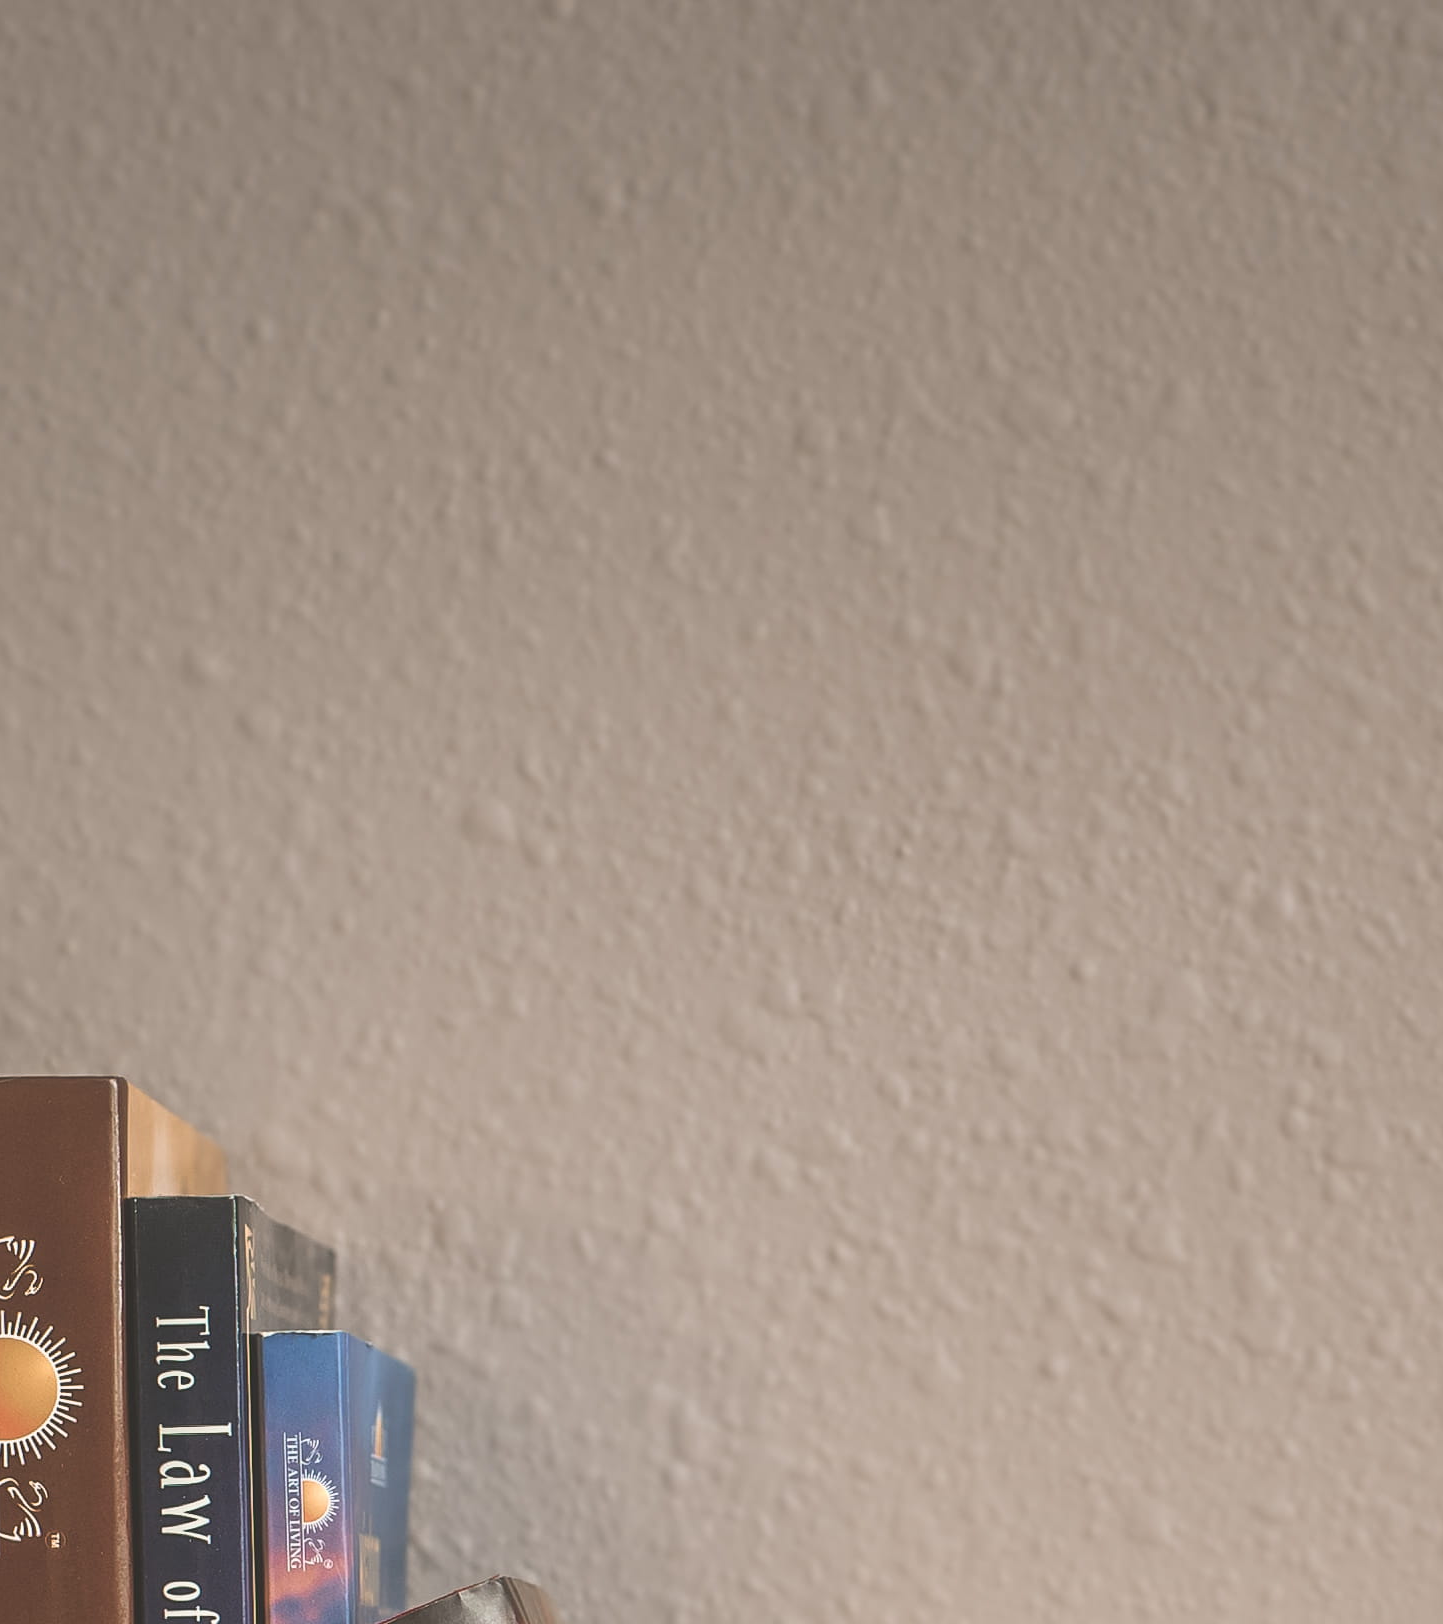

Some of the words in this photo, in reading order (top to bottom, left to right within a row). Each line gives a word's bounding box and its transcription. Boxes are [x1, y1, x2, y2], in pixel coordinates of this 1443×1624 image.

[154, 1304, 212, 1391] The
[284, 1434, 298, 1465] THE
[156, 1421, 234, 1546] Law
[286, 1467, 299, 1497] ART
[287, 1498, 299, 1519] OF
[287, 1521, 302, 1570] LIVING
